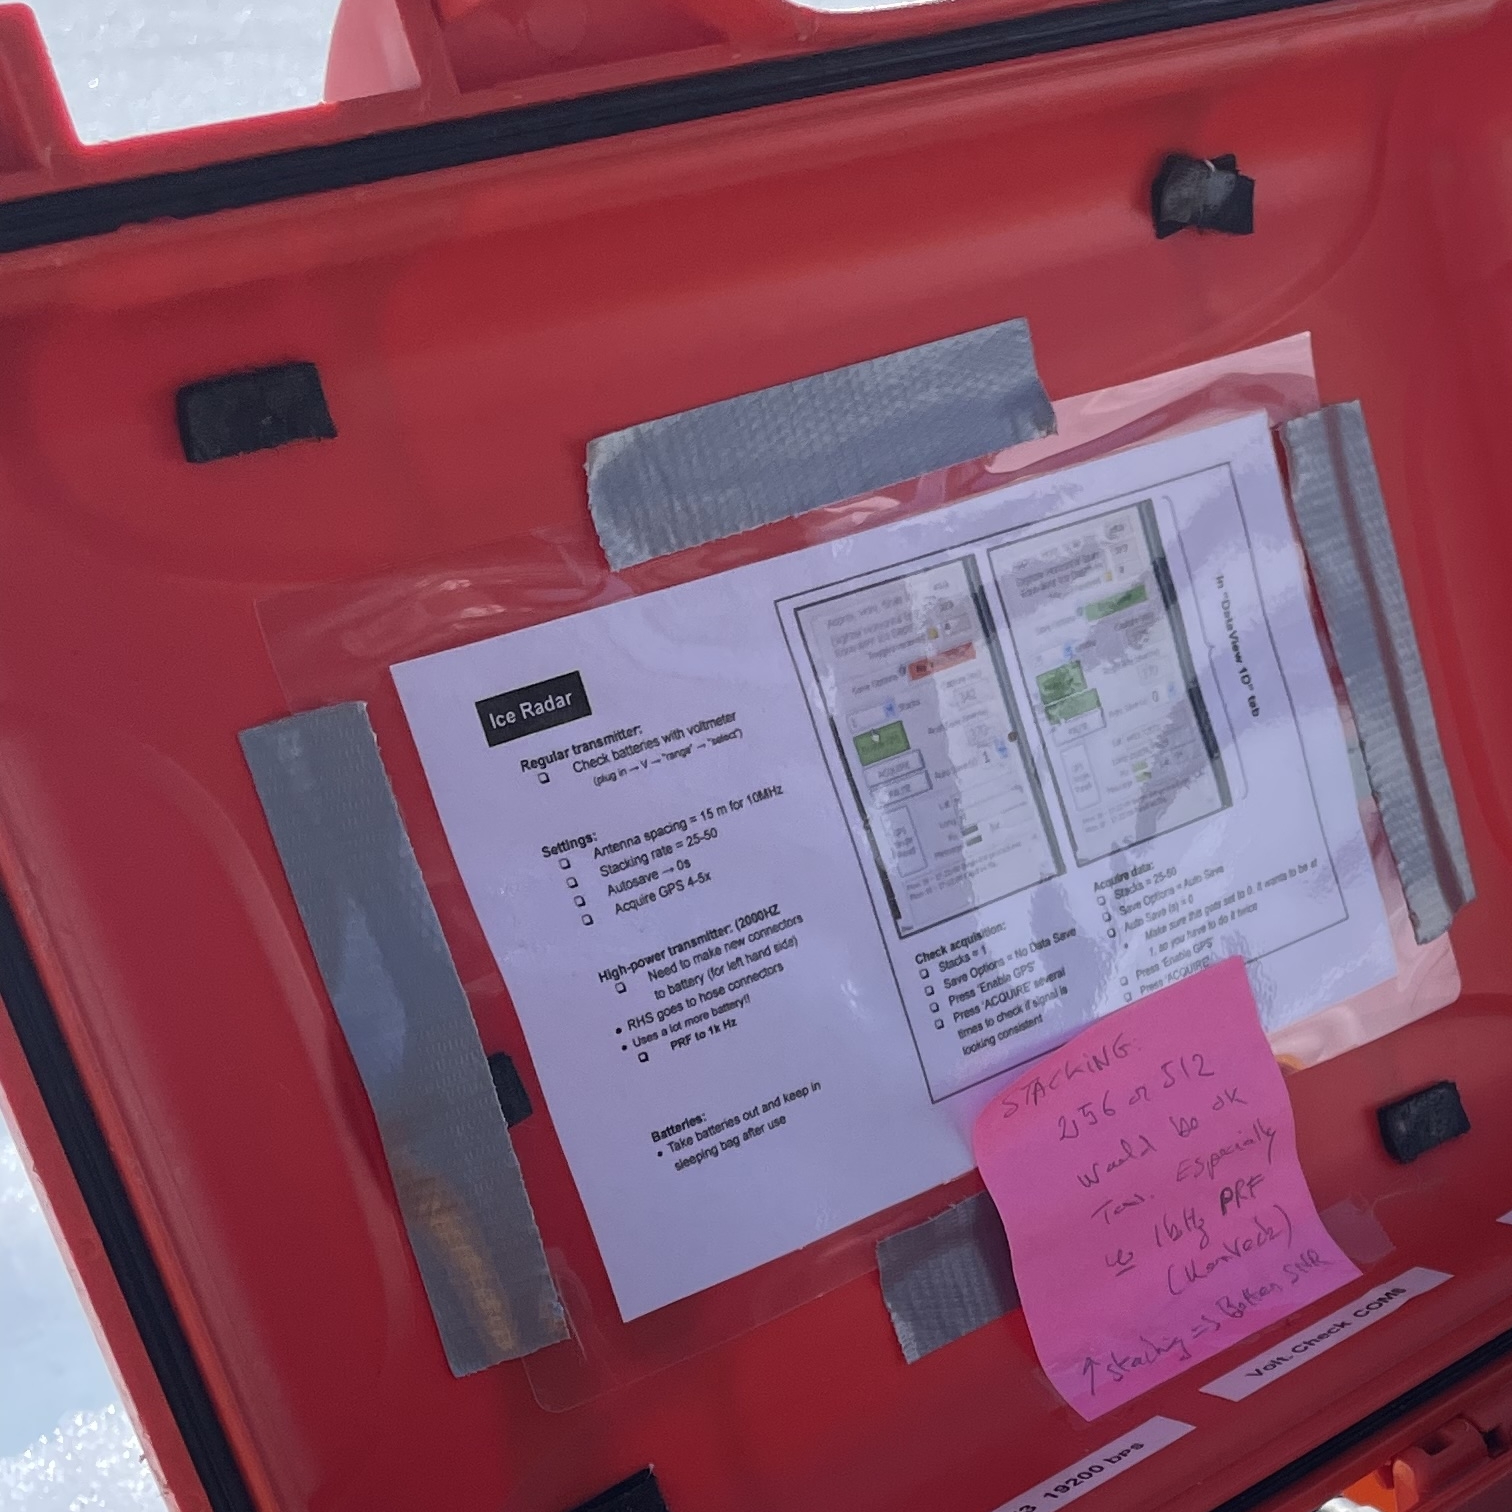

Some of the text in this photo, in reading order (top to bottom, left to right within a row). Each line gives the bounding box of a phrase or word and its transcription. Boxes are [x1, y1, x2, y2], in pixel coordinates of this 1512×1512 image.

[488, 692, 572, 729] Ice Radar
[1248, 695, 1260, 717] tab
[519, 724, 643, 773] Regular transmitter:
[572, 711, 736, 773] Check batteries with voltmeter
[541, 832, 598, 858] Settings:
[593, 834, 642, 860] Antenna
[643, 819, 688, 843] spacing
[699, 807, 714, 821] 15
[715, 804, 728, 817] m
[728, 798, 744, 812] for
[599, 826, 718, 877] Stacking rate 25-50
[607, 858, 692, 897] Autosave 0s
[615, 891, 657, 915] Acquire
[658, 878, 685, 898] GPS
[597, 949, 666, 983] High-power
[647, 914, 804, 983] Need to make new connectors
[914, 923, 1006, 965] Check acquisition:
[938, 944, 987, 973] Stacks 1
[943, 927, 1077, 989] Save Options No Data Save
[653, 935, 799, 1001] to battery (for left hand side)
[626, 962, 785, 1031] RHS goes to hose connectors
[957, 985, 1069, 1040] times to check if signal is
[631, 1031, 659, 1048] Uses
[660, 1027, 668, 1037] a
[668, 1020, 683, 1033] lot
[683, 1011, 710, 1028] more
[961, 1013, 1044, 1056] looking consistent
[666, 1081, 822, 1153] Take batteries out and keep in
[1058, 1090, 1116, 1141] 256
[1161, 1054, 1215, 1089] 512
[650, 1112, 707, 1143] Batteries:
[674, 1115, 787, 1172] sleeping bag after use
[1220, 1174, 1265, 1215] PRF
[1292, 1321, 1352, 1353] Check
[1043, 1463, 1104, 1501] 19200
[1103, 1441, 1145, 1466] bps
